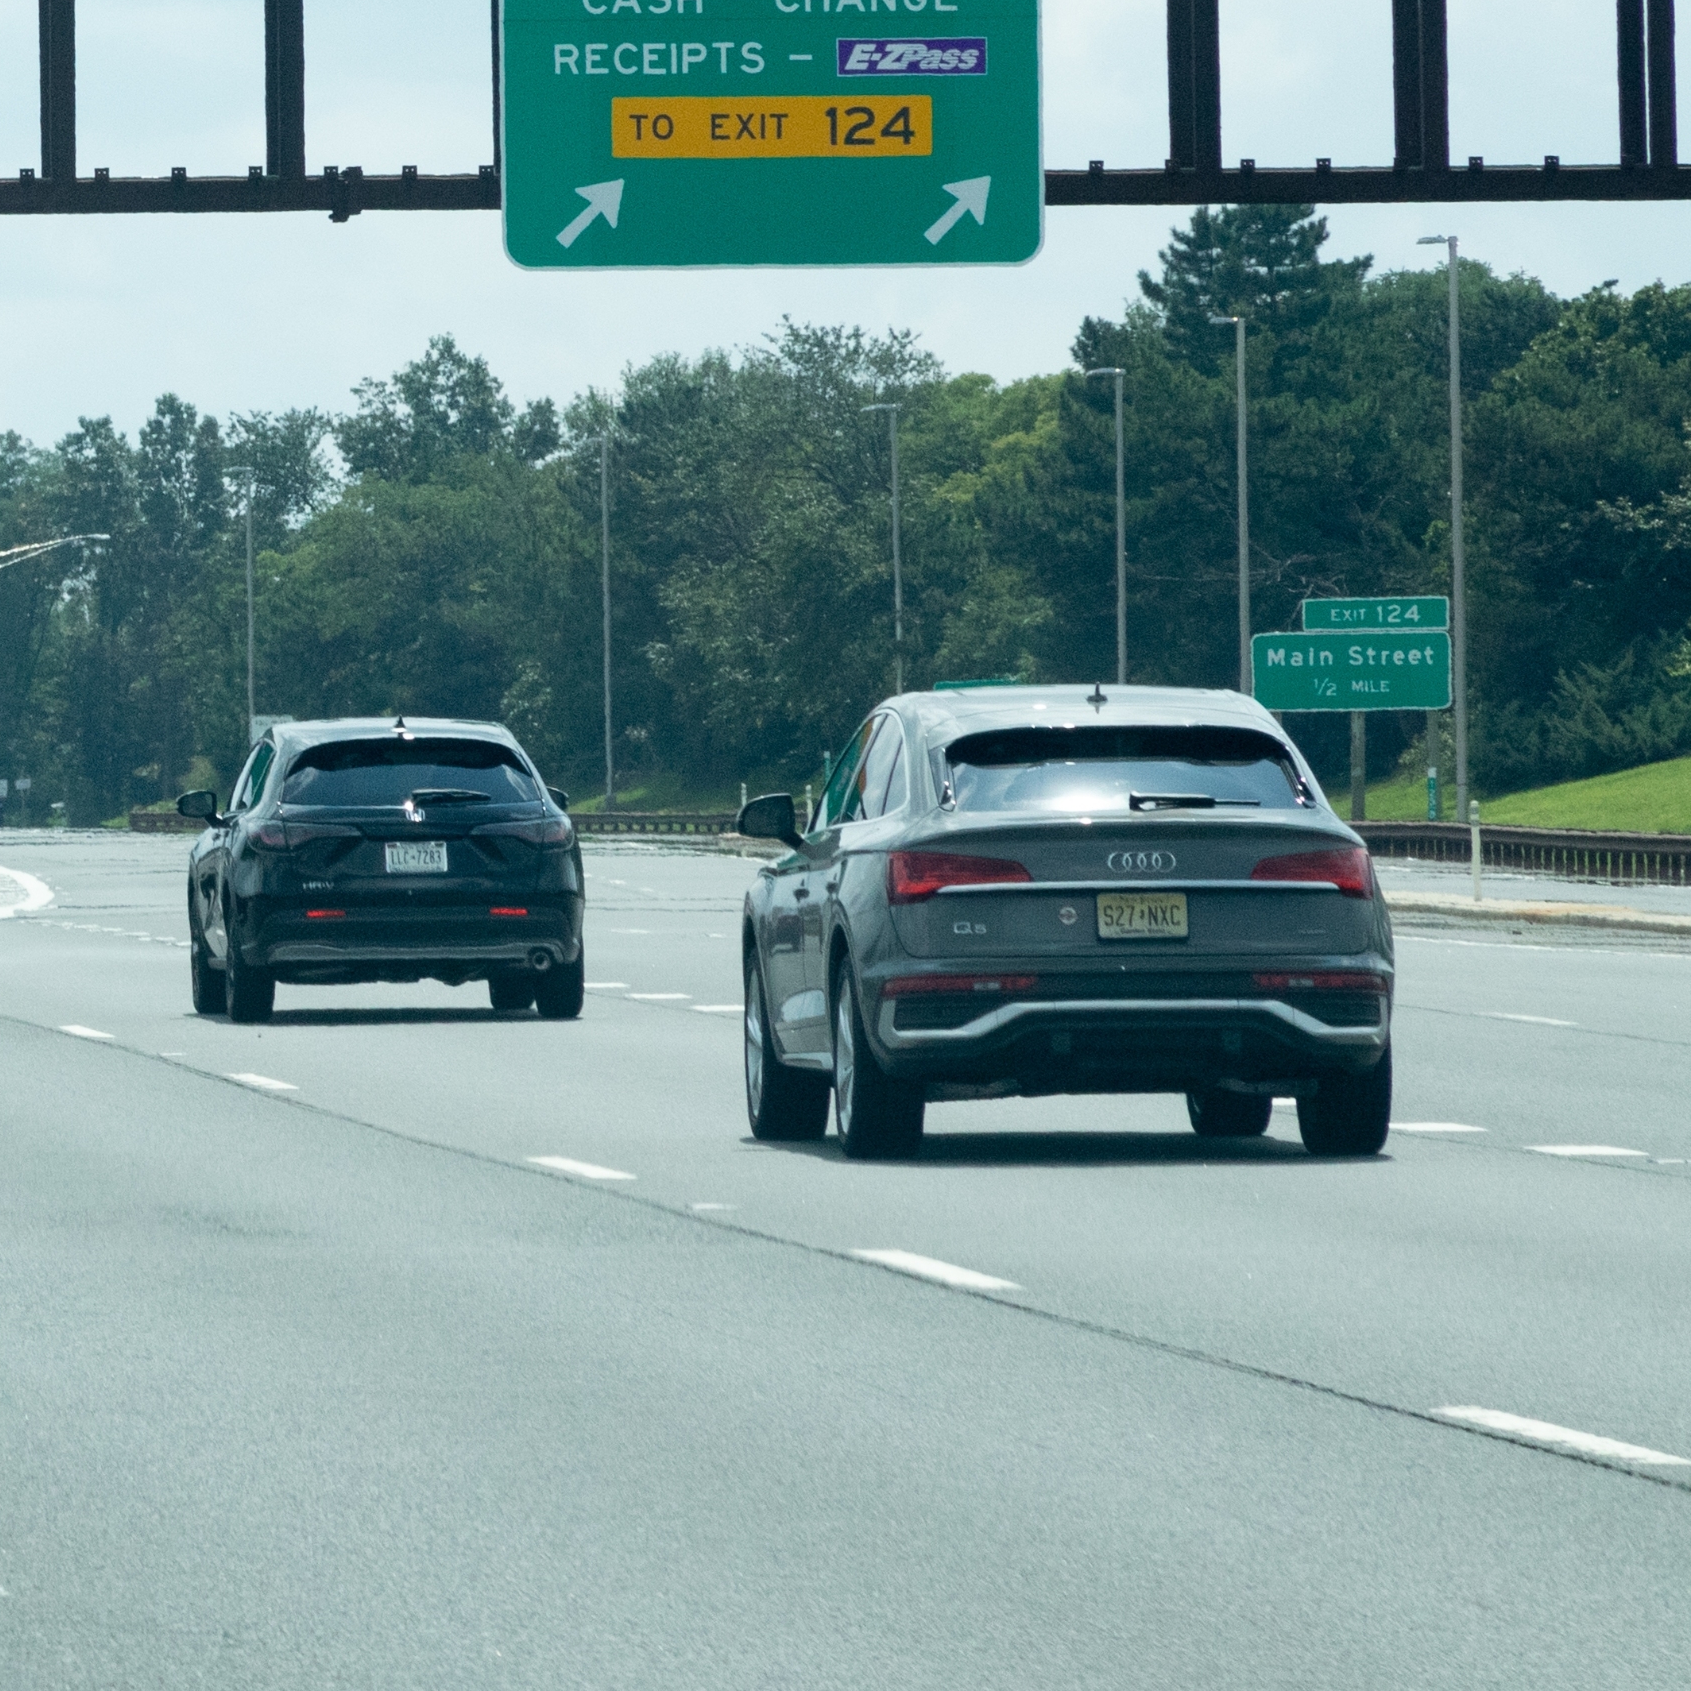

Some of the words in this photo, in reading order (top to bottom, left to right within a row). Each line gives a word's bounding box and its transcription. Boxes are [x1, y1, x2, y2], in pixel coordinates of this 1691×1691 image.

[553, 41, 766, 75] RECEIPTS
[845, 41, 984, 71] E-ZPass
[629, 113, 675, 141] TO
[710, 113, 789, 141] EXIT
[824, 106, 916, 146] 124
[1330, 608, 1366, 622] EXIT
[1376, 604, 1421, 623] 124
[1266, 646, 1334, 667] Main
[1348, 645, 1435, 666] Street
[1351, 680, 1390, 693] MILE
[1103, 904, 1135, 927] S27
[1147, 903, 1181, 927] NXC
